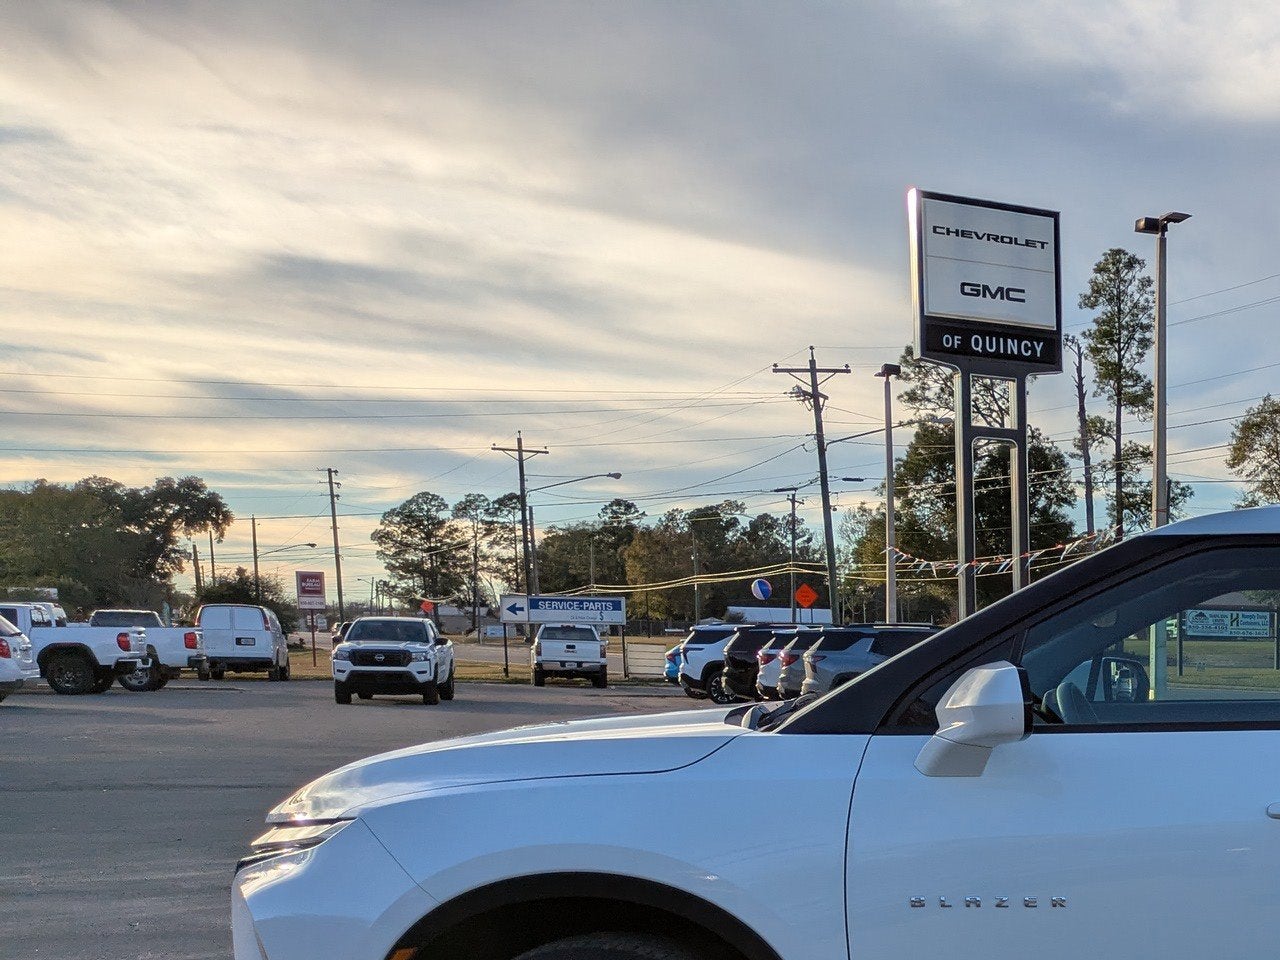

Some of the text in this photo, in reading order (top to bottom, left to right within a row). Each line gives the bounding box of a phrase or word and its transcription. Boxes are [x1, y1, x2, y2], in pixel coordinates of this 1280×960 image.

[932, 225, 1049, 250] CHEVROLET
[960, 281, 1026, 304] GMC
[942, 334, 1044, 358] OF QUINCY
[909, 895, 1067, 908] BLAZER
